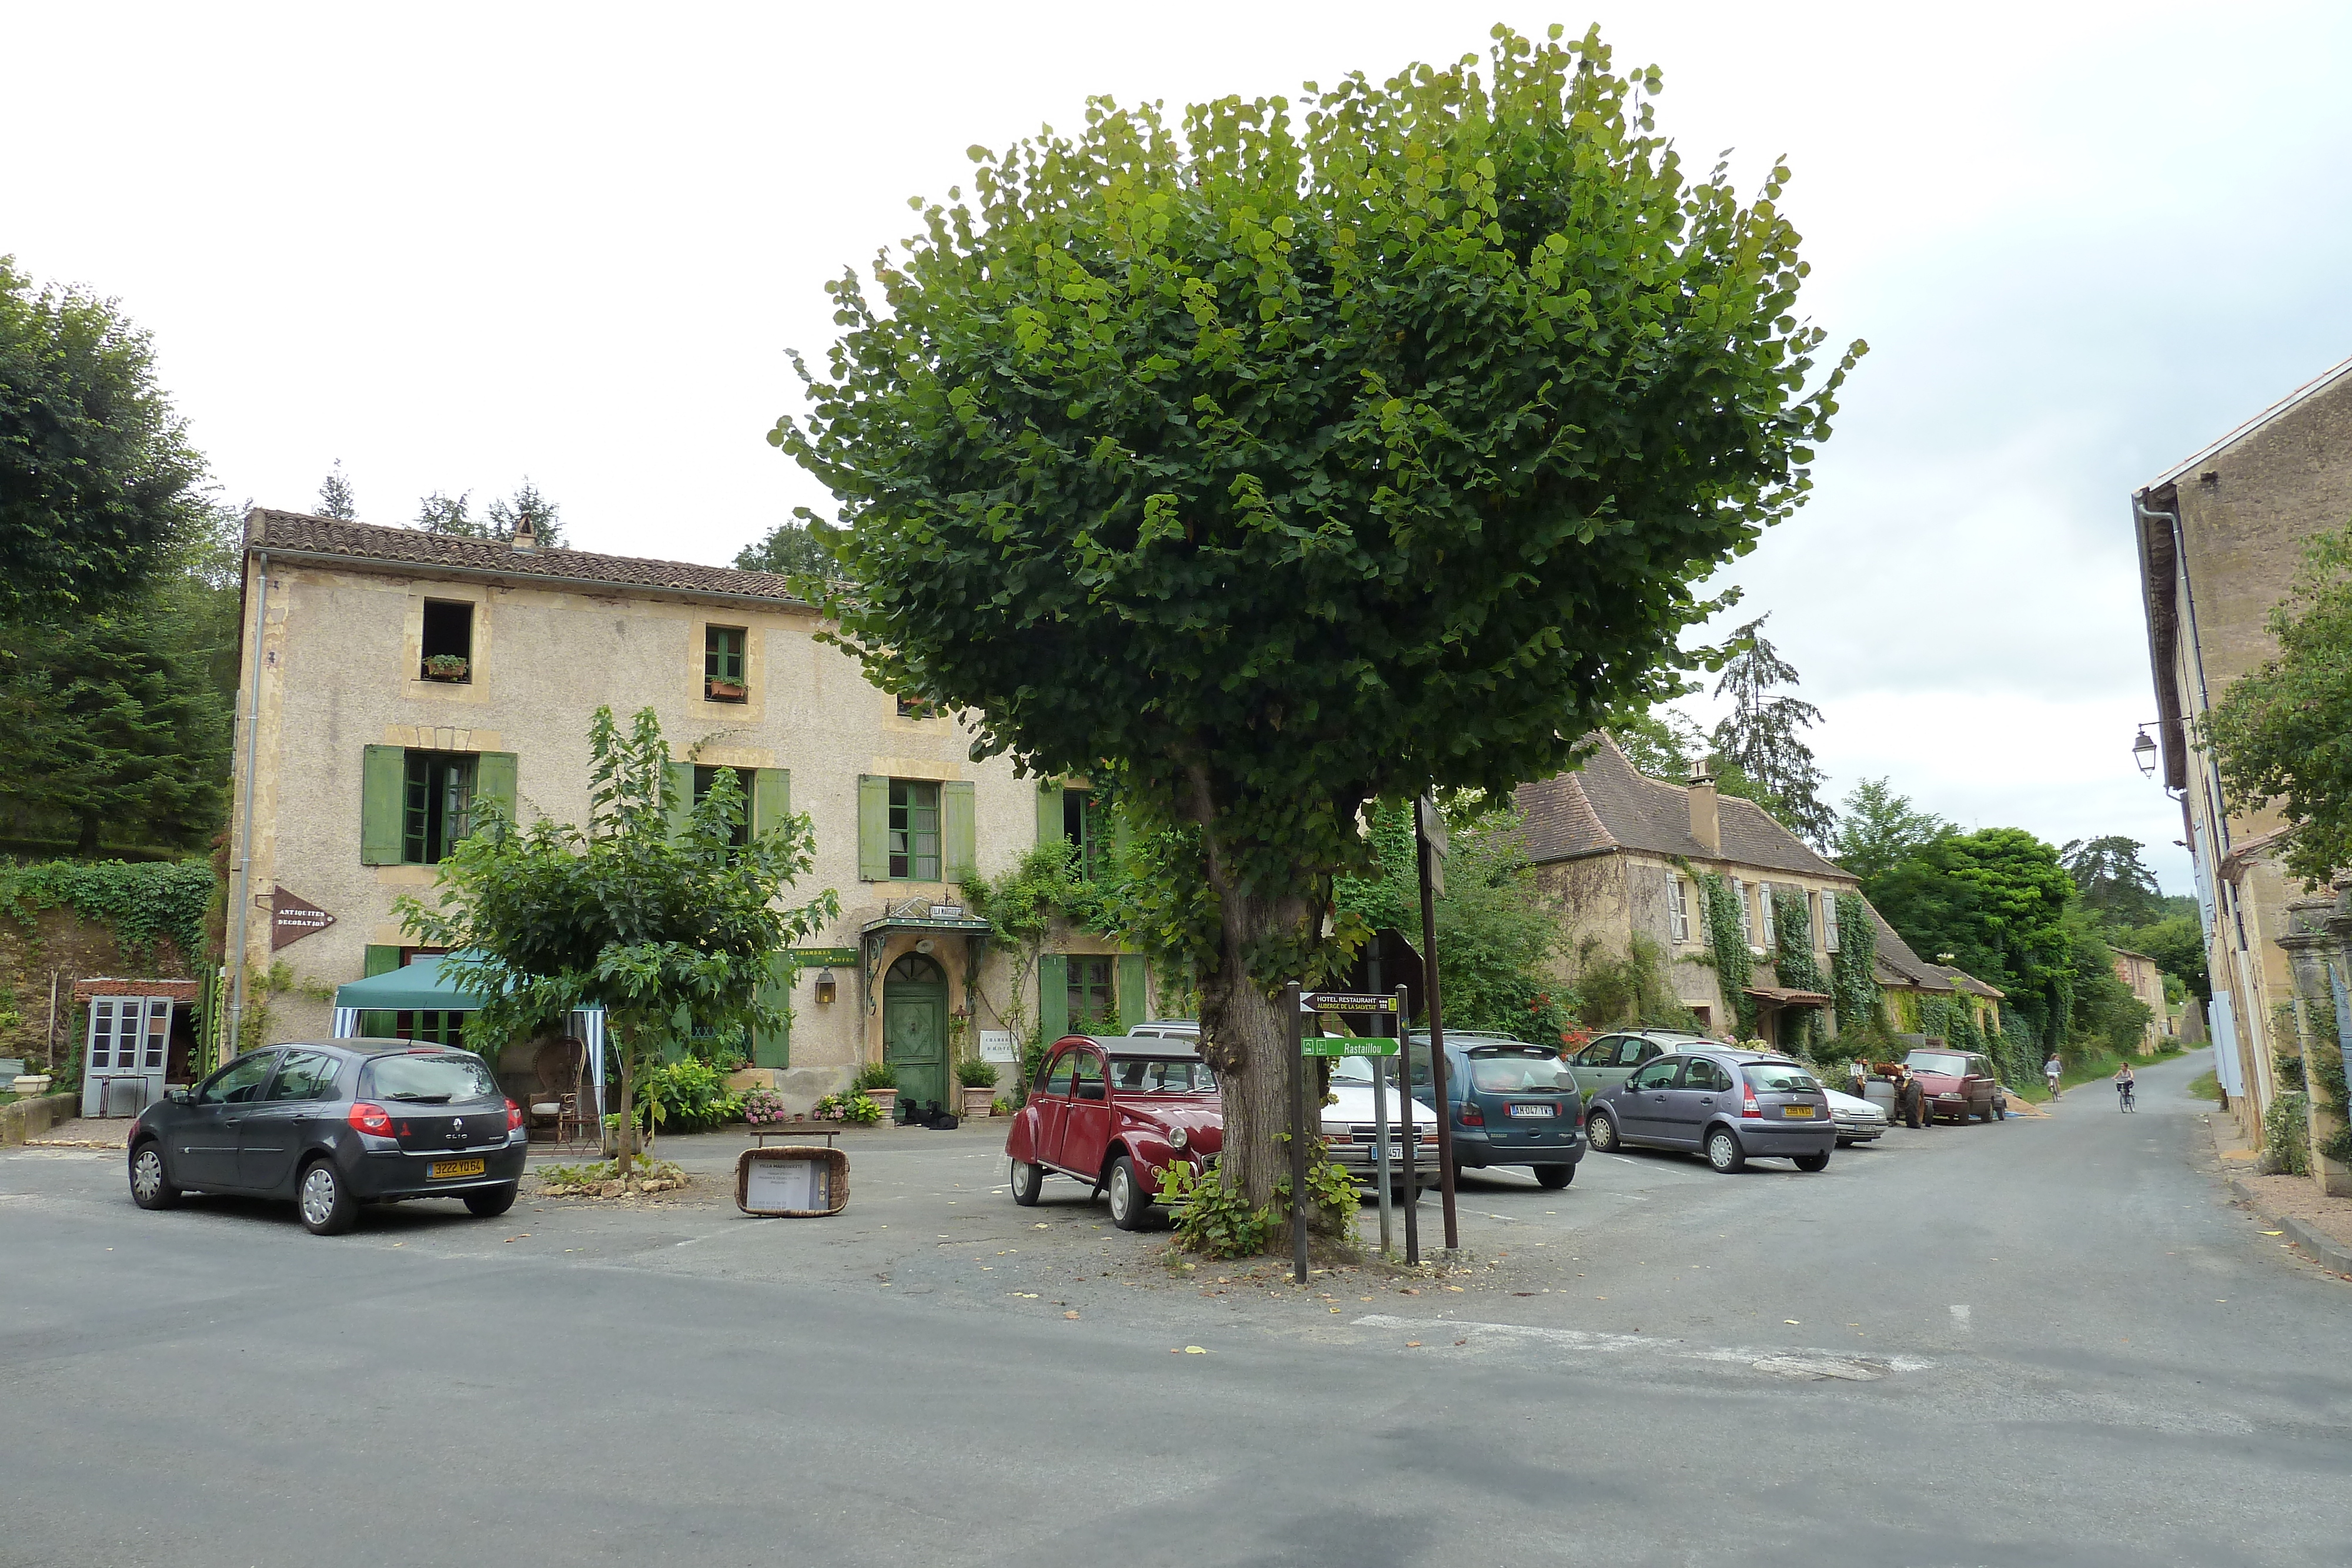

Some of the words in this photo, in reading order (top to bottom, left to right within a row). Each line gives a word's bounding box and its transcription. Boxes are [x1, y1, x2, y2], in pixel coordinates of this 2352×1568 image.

[1344, 1042, 1382, 1054] Rastaillou
[436, 1162, 457, 1174] 3222
[470, 1160, 480, 1171] 64
